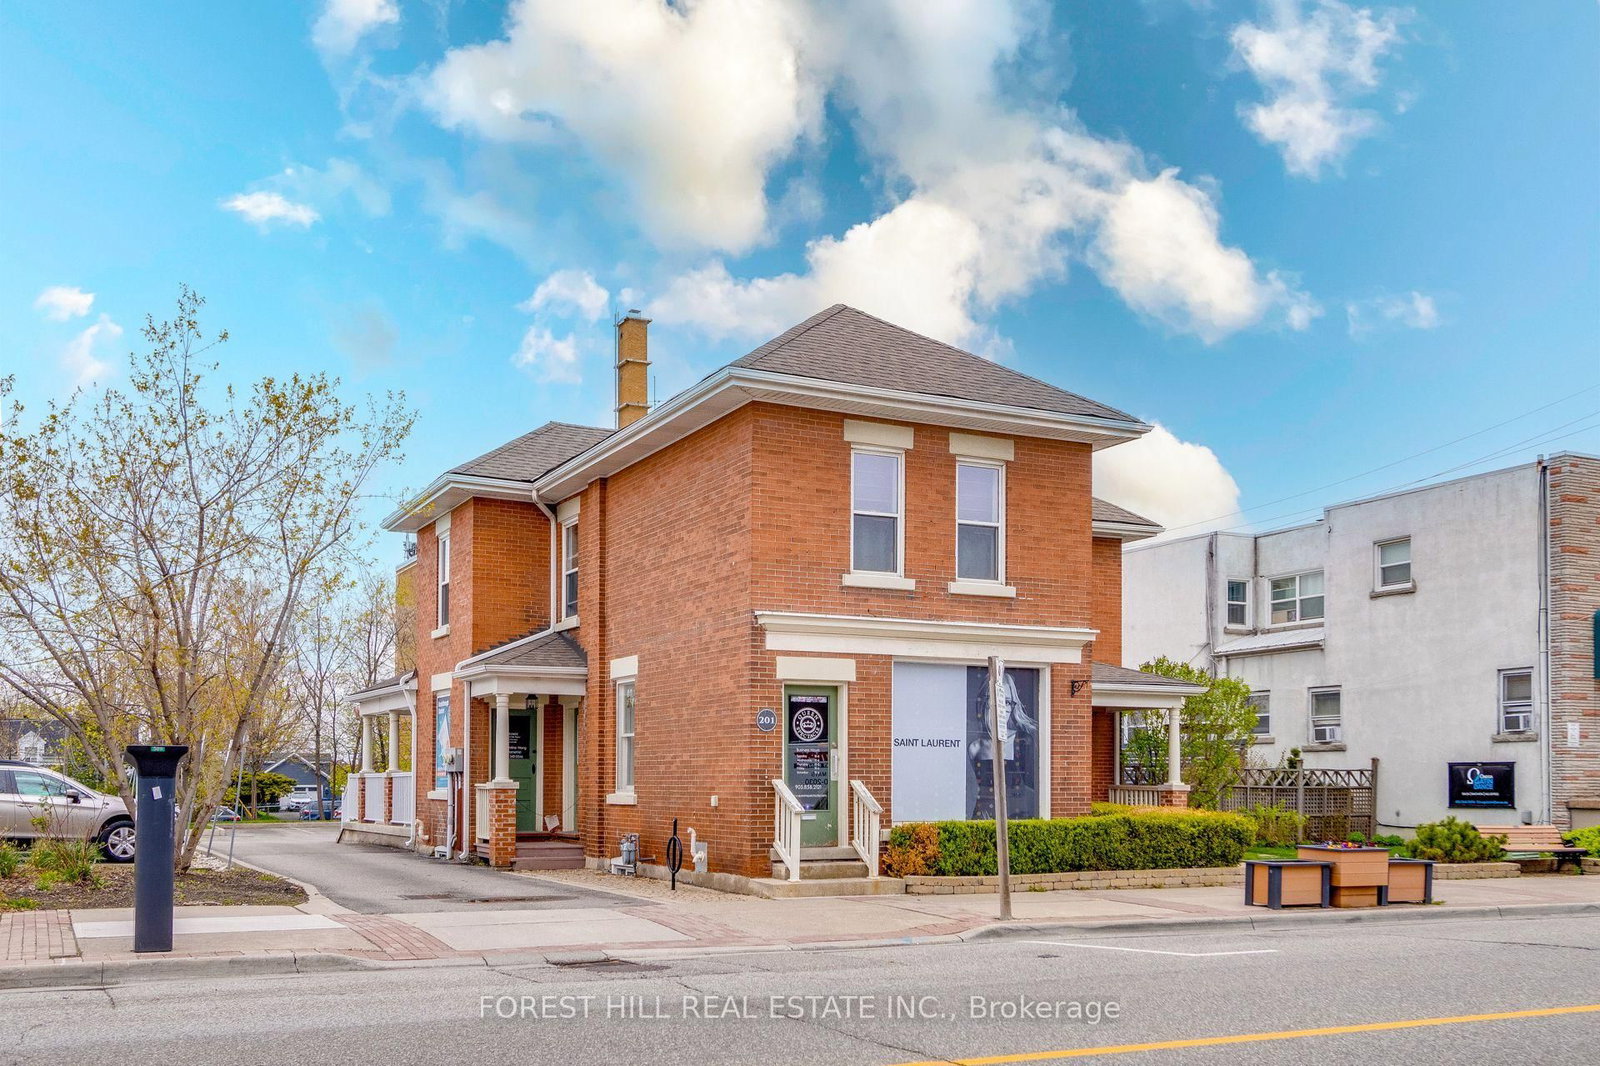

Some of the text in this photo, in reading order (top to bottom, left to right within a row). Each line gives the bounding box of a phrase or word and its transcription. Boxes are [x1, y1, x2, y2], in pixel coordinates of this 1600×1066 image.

[758, 716, 775, 724] 201
[797, 710, 819, 720] QUEEN
[796, 726, 820, 739] SPECTACLE
[893, 738, 961, 748] SAINT LAURENT
